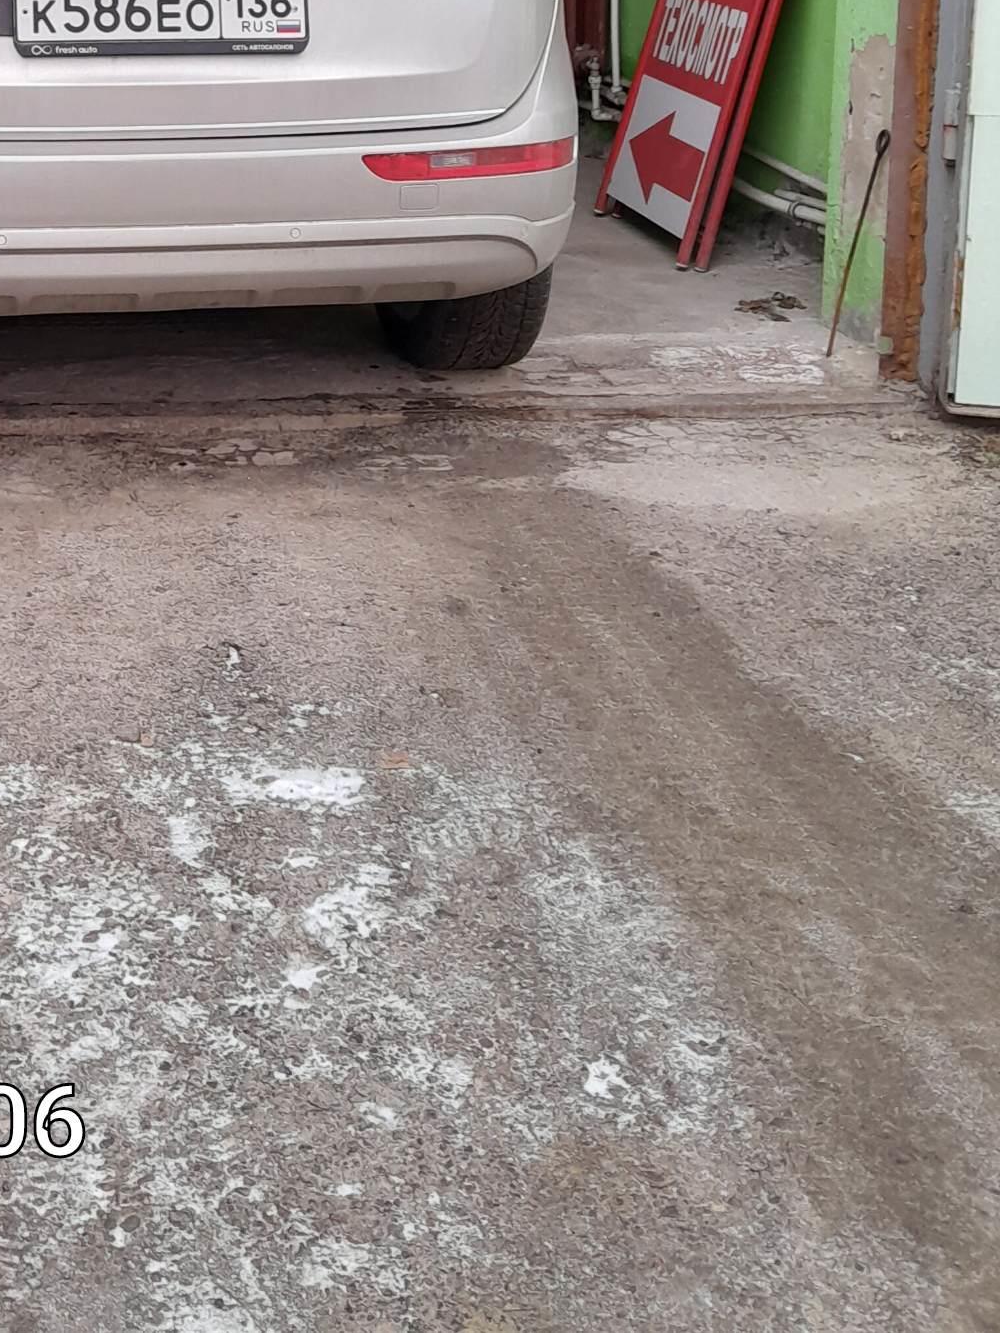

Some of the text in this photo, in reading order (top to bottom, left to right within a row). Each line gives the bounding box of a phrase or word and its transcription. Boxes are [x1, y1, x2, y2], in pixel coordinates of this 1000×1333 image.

[241, 20, 275, 34] RUS
[55, 45, 99, 54] fresh auto
